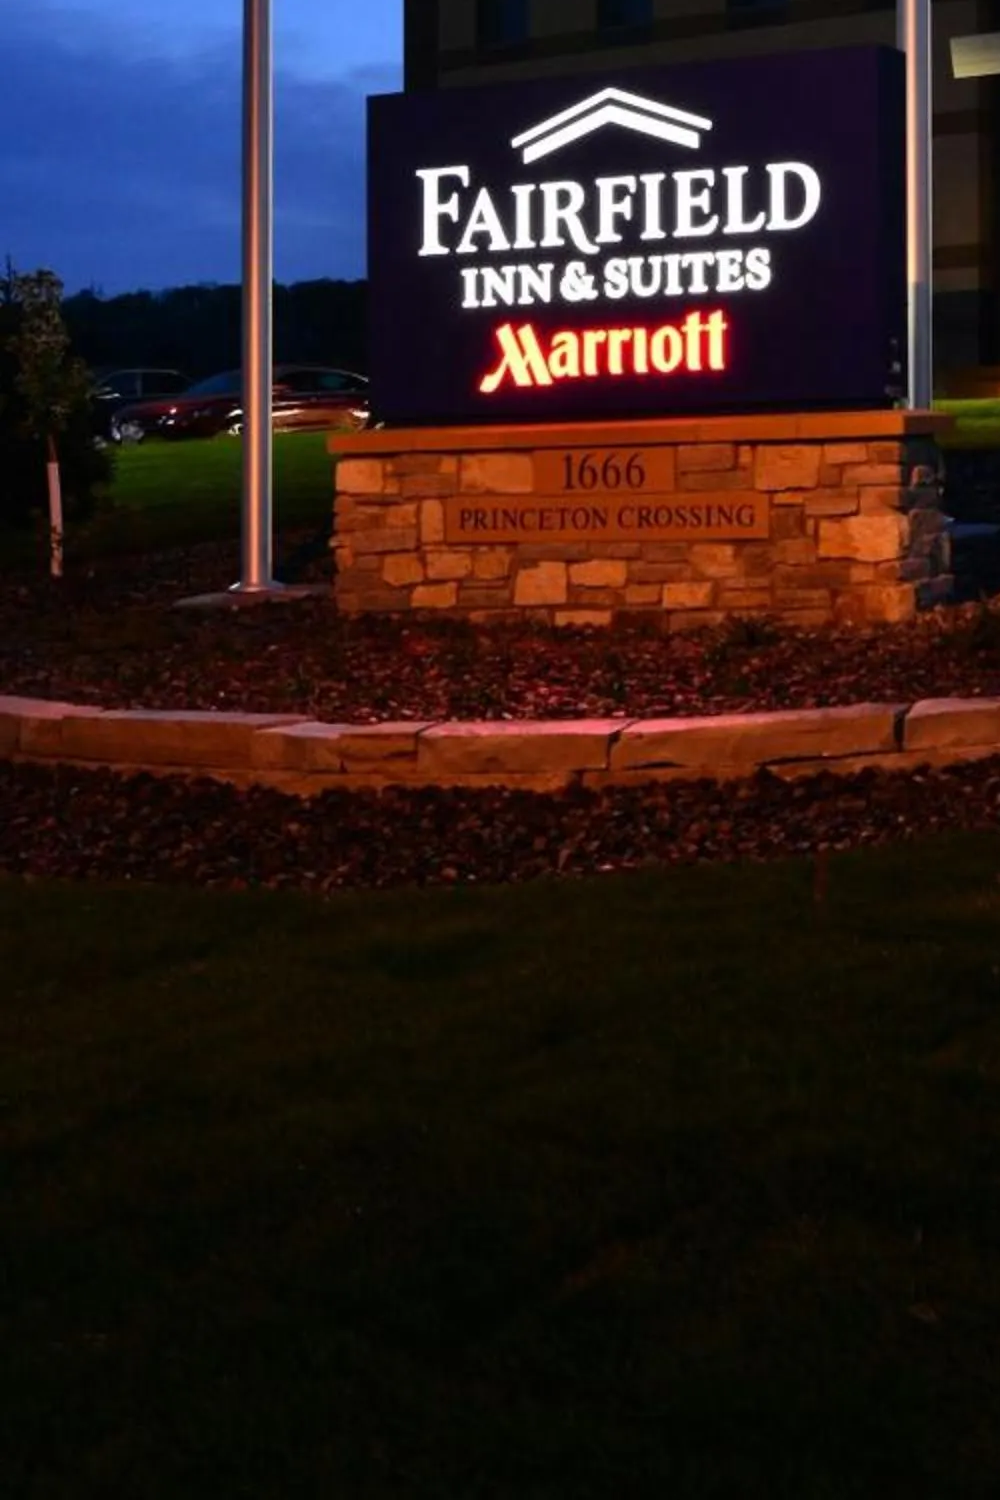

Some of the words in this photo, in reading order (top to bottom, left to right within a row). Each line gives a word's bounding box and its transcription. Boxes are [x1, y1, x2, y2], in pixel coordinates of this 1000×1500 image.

[415, 160, 822, 257] FAIRFIELD
[477, 308, 728, 394] Marriott
[563, 453, 646, 490] 1666
[459, 507, 608, 532] PRINCETON
[617, 503, 756, 531] CROSSING
